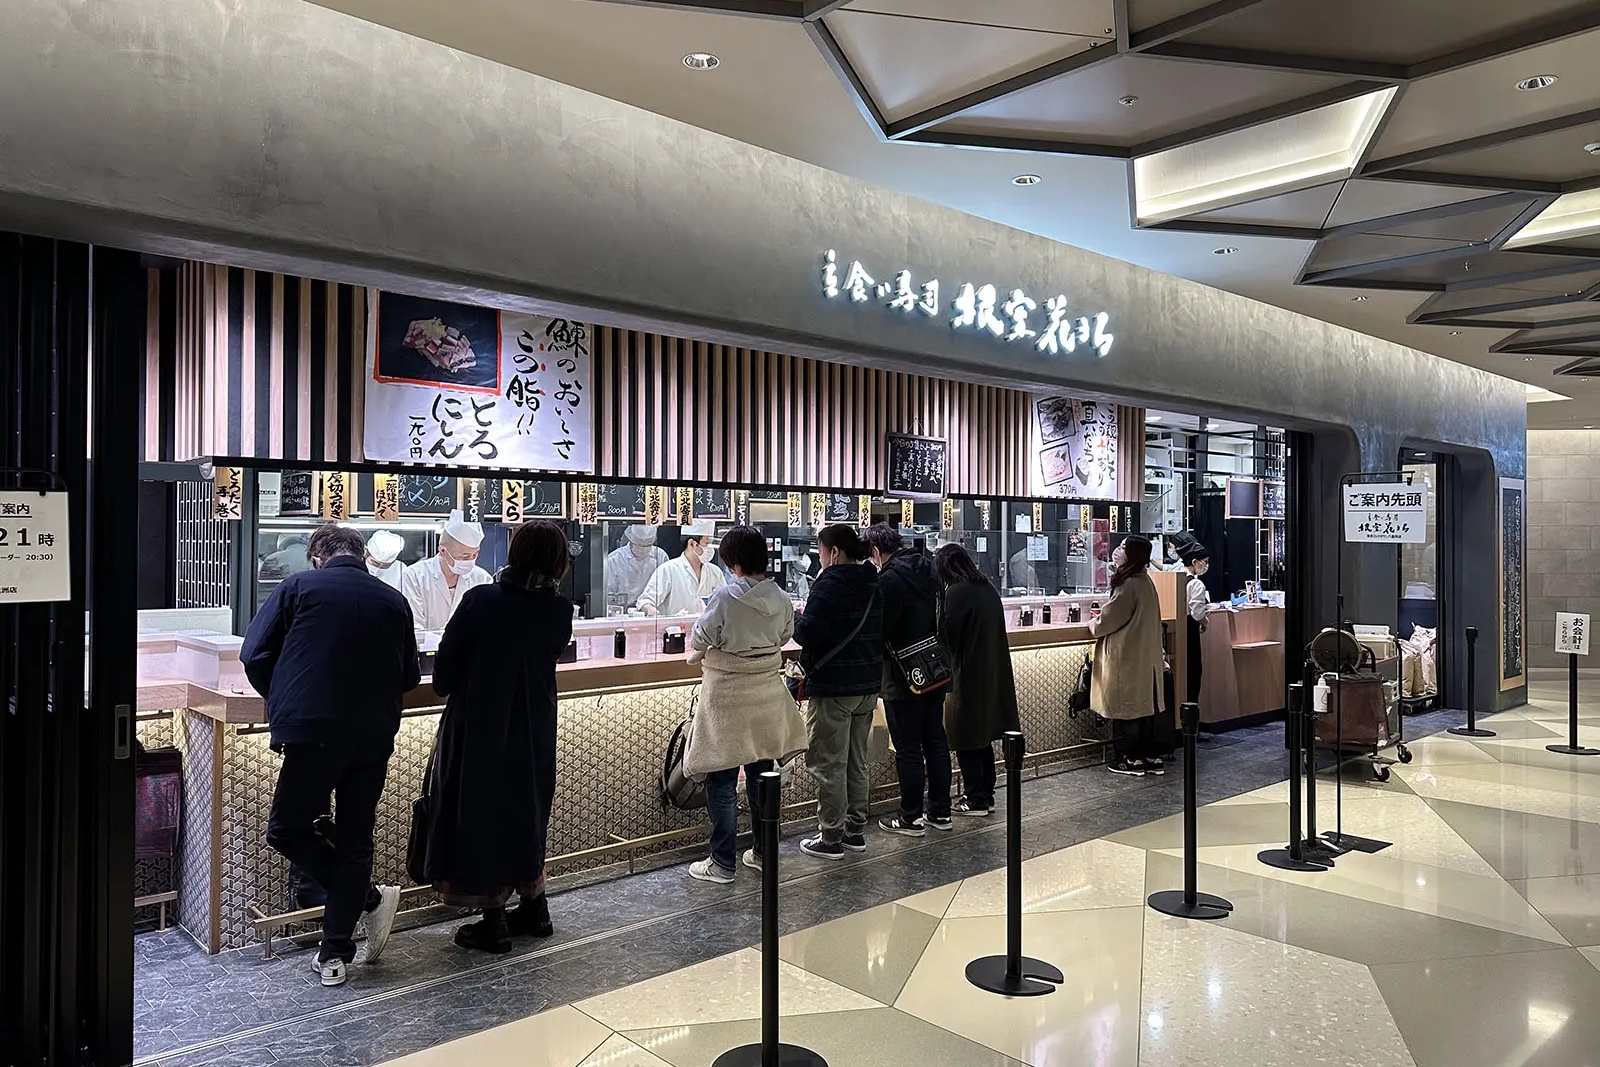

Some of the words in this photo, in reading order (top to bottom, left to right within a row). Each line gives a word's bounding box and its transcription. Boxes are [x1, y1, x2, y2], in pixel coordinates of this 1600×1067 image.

[949, 282, 1114, 358] 根室花まる
[428, 393, 464, 459] にしん
[468, 396, 499, 460] とろ
[0, 502, 31, 515] 案内
[216, 485, 230, 518] 手巻
[229, 468, 241, 518] とろたく
[376, 489, 387, 519] ほたて
[505, 480, 523, 522] いくら
[1348, 492, 1423, 507] ご案内先頭
[1572, 617, 1584, 651] お会計は
